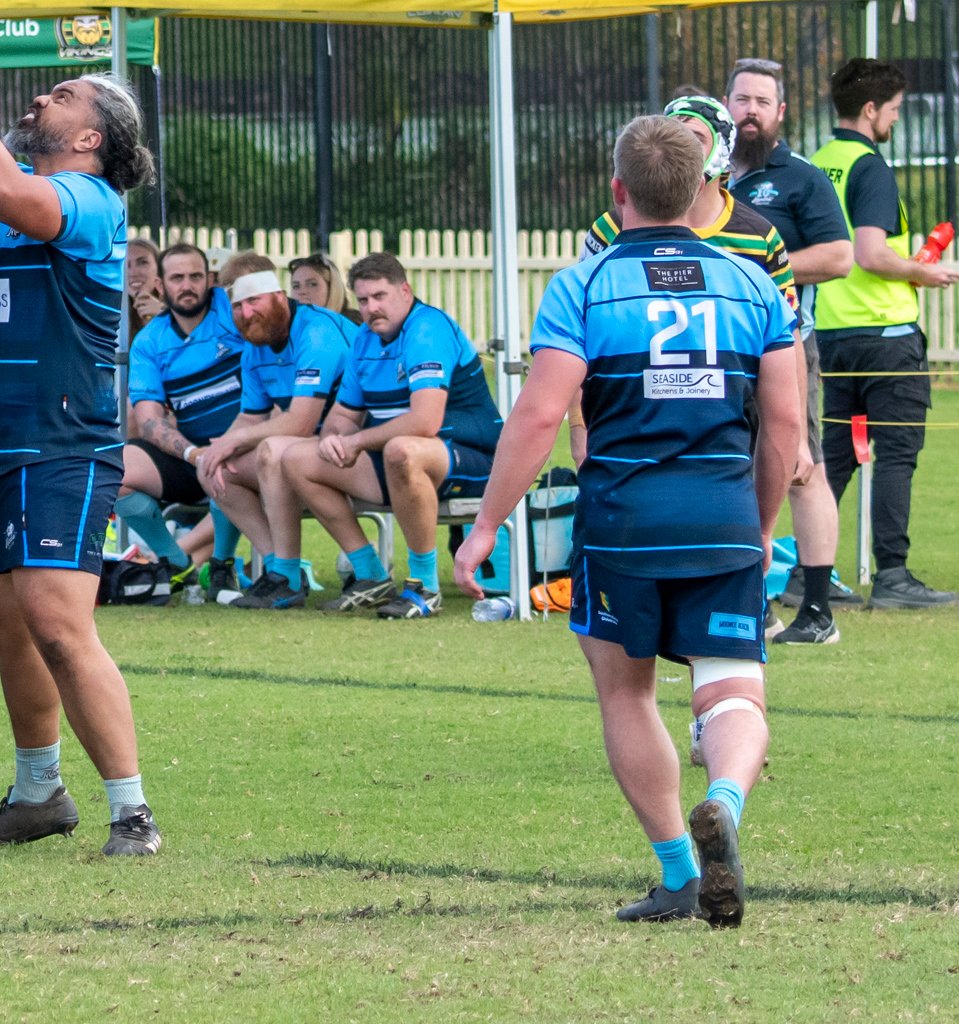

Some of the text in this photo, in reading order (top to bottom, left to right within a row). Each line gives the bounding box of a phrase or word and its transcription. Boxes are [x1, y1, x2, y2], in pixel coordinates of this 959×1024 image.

[647, 300, 717, 365] 21
[652, 373, 693, 384] SEASIDE
[686, 387, 711, 395] Joinery
